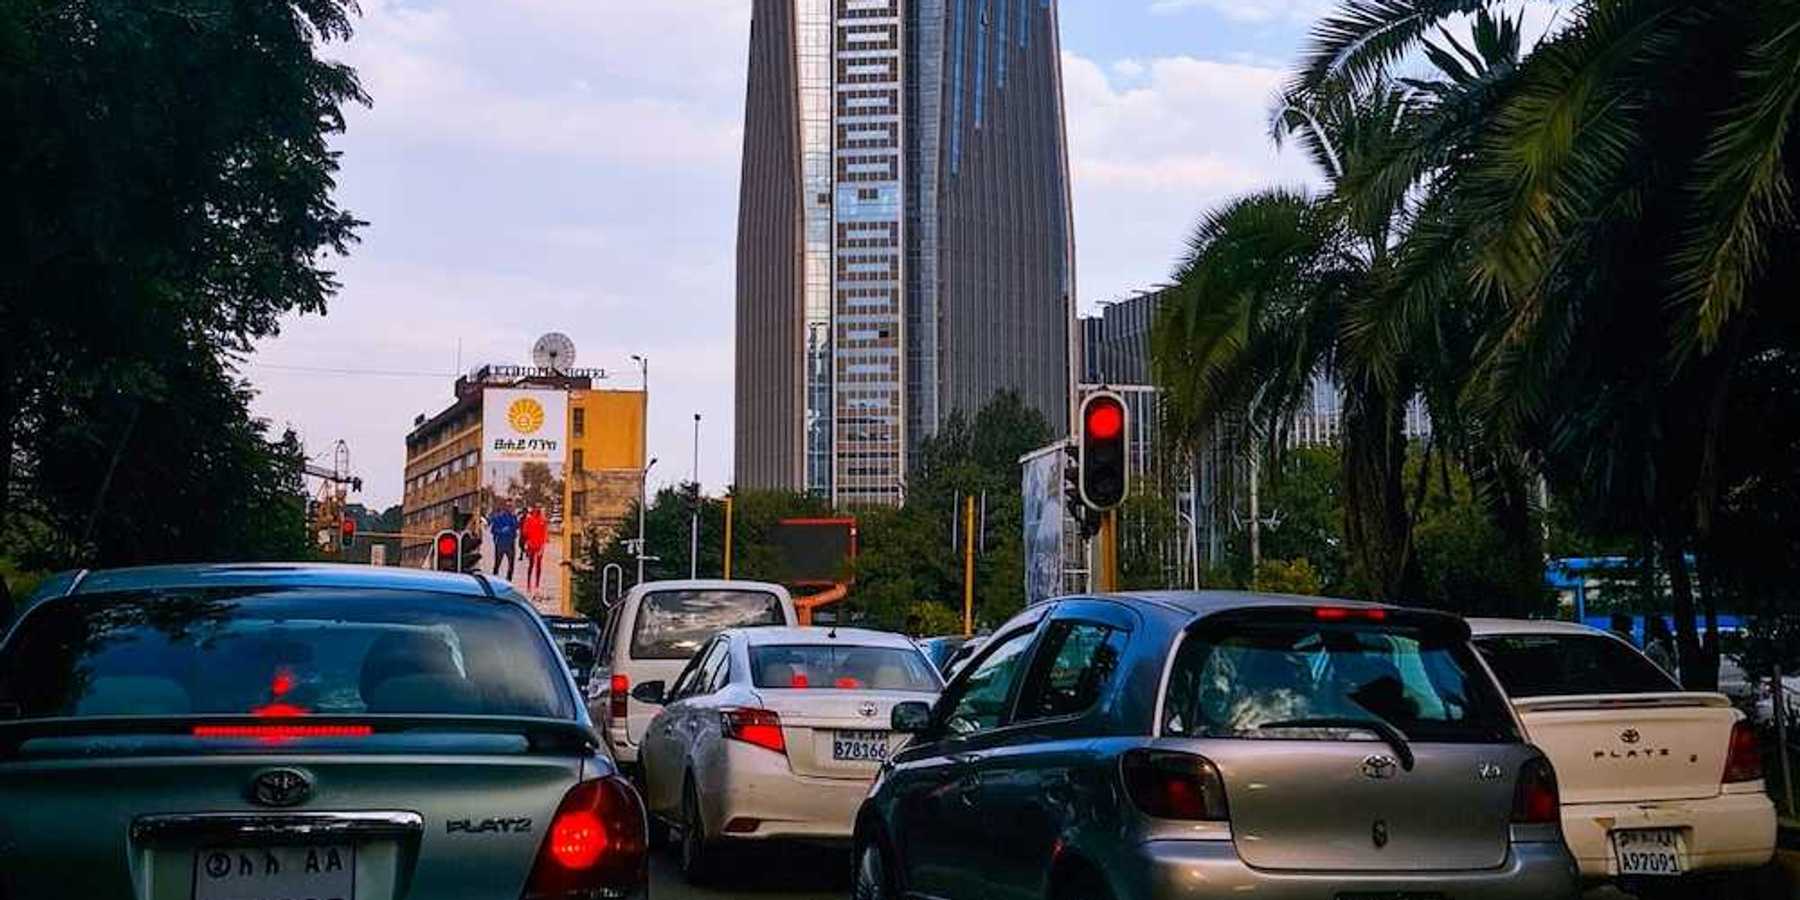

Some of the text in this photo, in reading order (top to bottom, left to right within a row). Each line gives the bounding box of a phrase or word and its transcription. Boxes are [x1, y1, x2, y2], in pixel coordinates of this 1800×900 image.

[446, 818, 533, 833] PLATZ
[305, 848, 342, 873] AA
[1622, 852, 1680, 873] A97091
